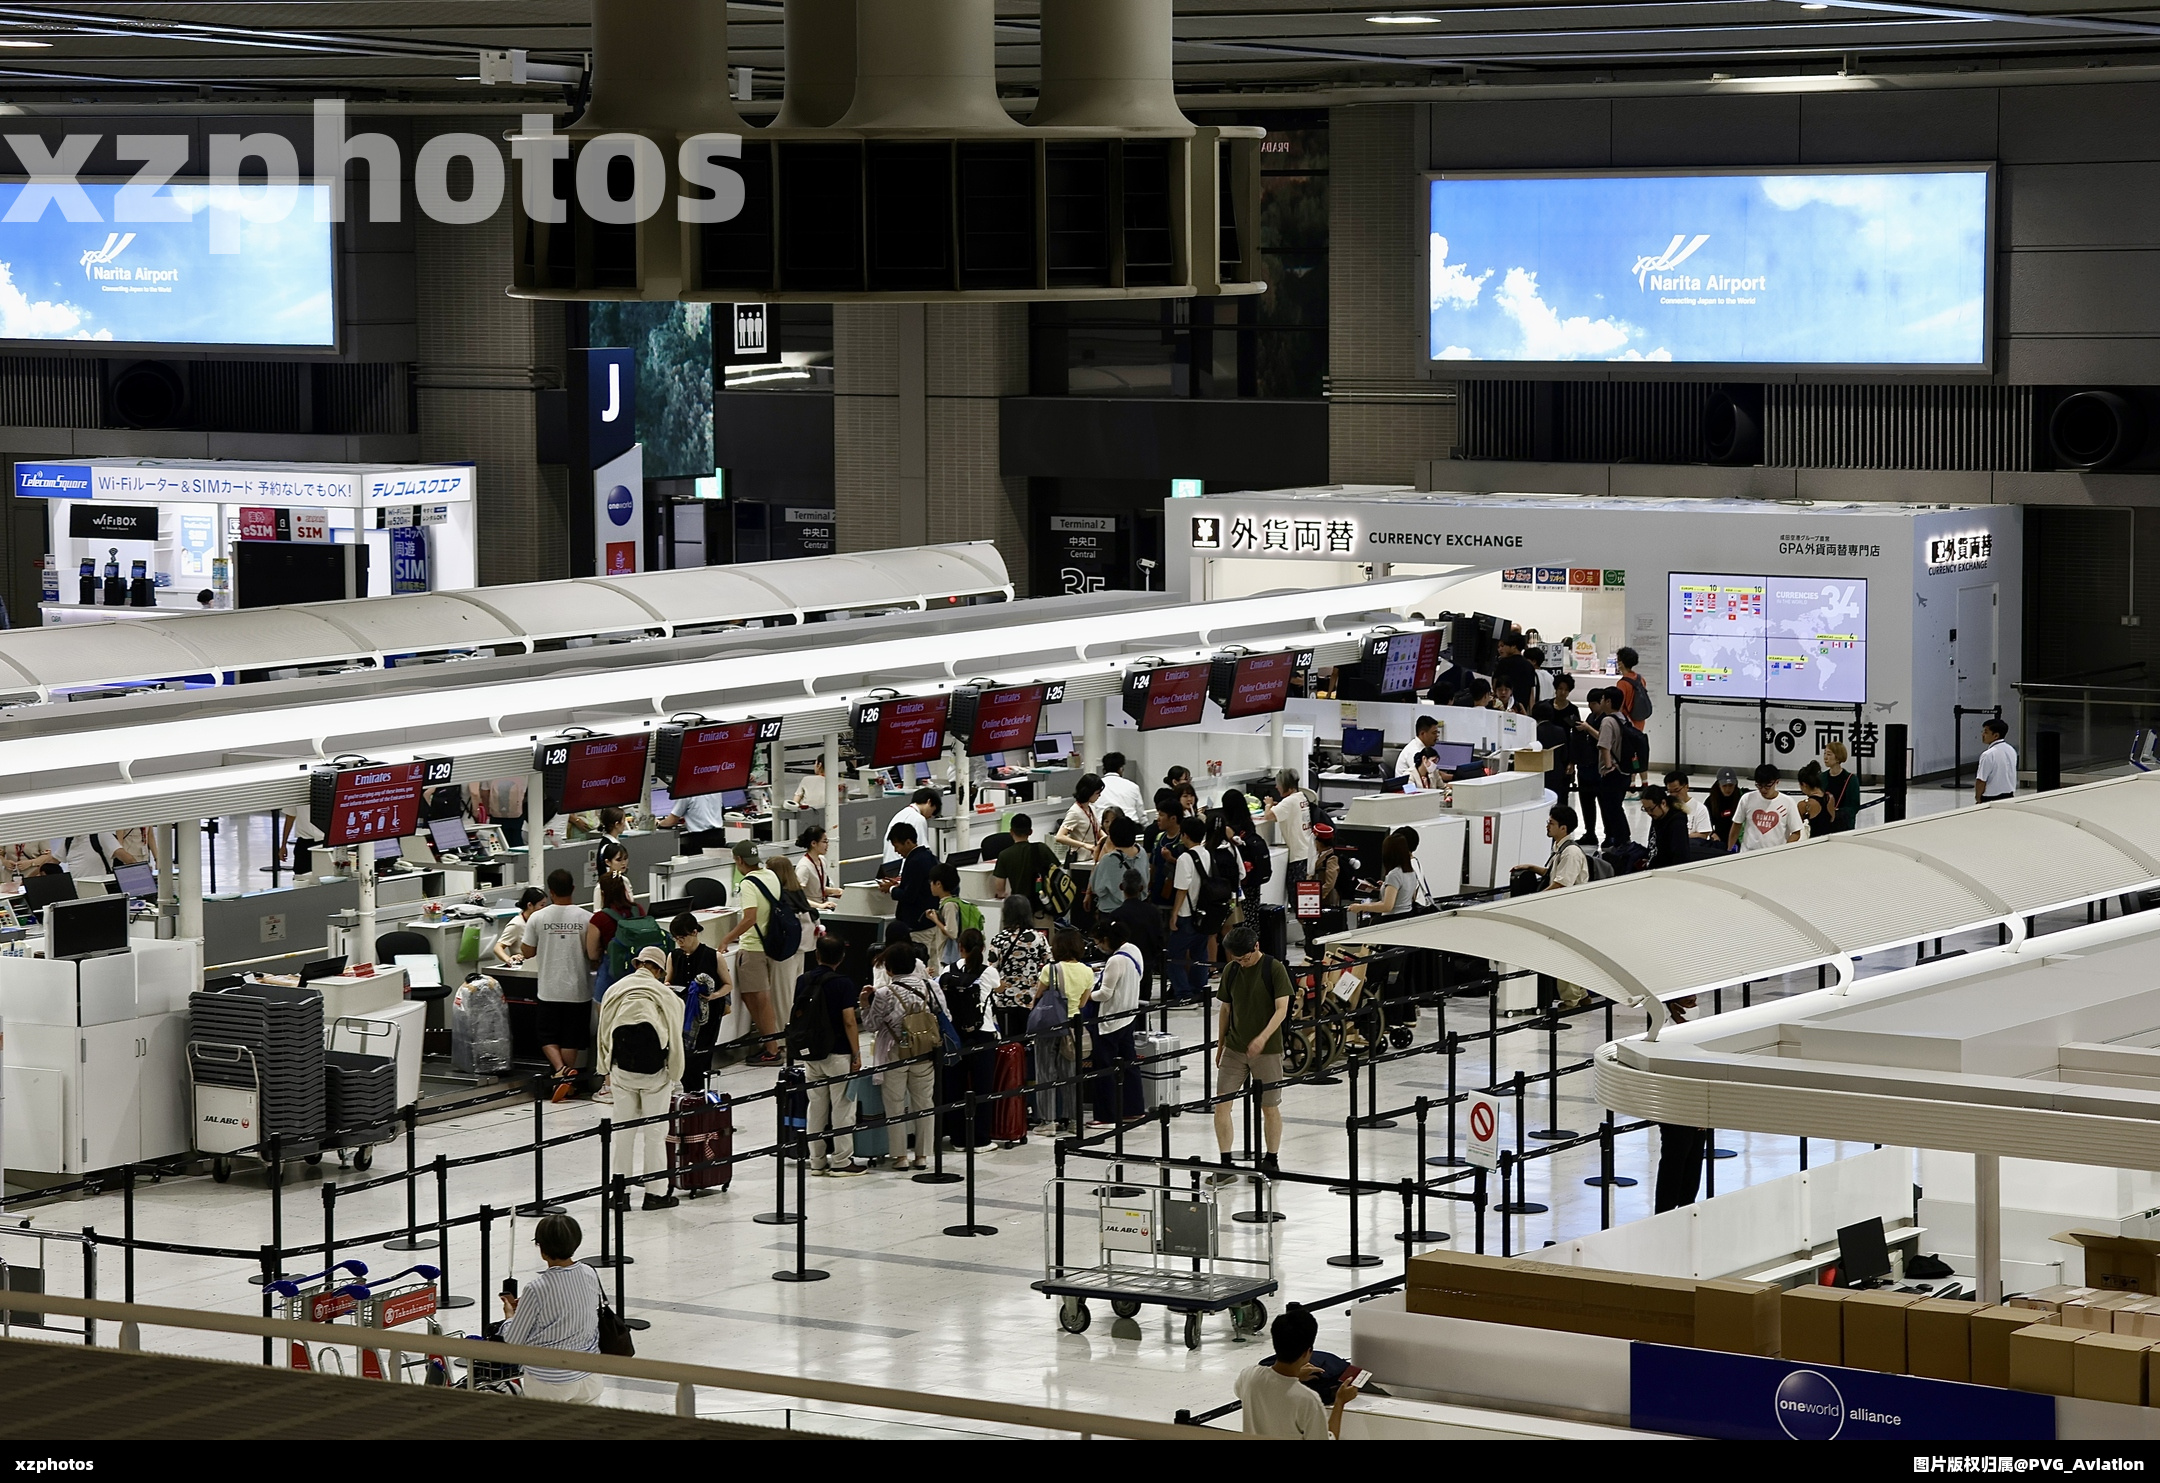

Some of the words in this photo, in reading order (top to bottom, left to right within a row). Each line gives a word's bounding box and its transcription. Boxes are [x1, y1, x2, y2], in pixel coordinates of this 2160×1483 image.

[94, 267, 131, 280] Narita
[135, 267, 179, 284] Airport
[1650, 275, 1700, 290] Narita
[1706, 275, 1766, 294] Airport
[1660, 297, 1696, 305] Connecting
[1697, 297, 1716, 305] Japan
[602, 363, 620, 422] J
[372, 477, 461, 497] テレコムスクエア
[794, 510, 830, 520] Terminal
[242, 525, 273, 537] eSIM
[1060, 519, 1098, 529] Terminal
[1100, 520, 1106, 529] 2
[298, 527, 322, 538] SIM
[803, 528, 829, 537] 中央口
[1231, 517, 1354, 552] 外貨両替
[1369, 531, 1440, 545] CURRENCY
[1446, 534, 1523, 548] EXCHANGE
[804, 541, 828, 549] Central
[1069, 536, 1096, 546] 中央口
[1945, 534, 1993, 562] 外貨両替
[395, 541, 416, 557] 周遊
[1070, 550, 1096, 558] Central
[1779, 542, 1880, 557] GPA外貨両替専門店
[395, 559, 425, 579] SIM
[1928, 564, 1957, 576] CURRENCY
[1958, 560, 1988, 573] EXCHANGE
[1776, 591, 1819, 600] CURRENCIES
[1821, 585, 1859, 618] 34
[1373, 641, 1388, 655] I-22
[1250, 660, 1274, 670] Emirates
[1296, 653, 1312, 667] I-23
[1133, 675, 1150, 689] I-24
[1165, 671, 1190, 681] Emirates
[1046, 686, 1064, 700] I-25
[1239, 684, 1256, 693] Online
[994, 693, 1021, 704] Emirates
[1153, 696, 1171, 705] Online
[1171, 692, 1199, 703] Checked-in
[1246, 693, 1272, 703] Customers
[861, 707, 879, 723] I-26
[897, 703, 924, 714] Emirates
[1160, 705, 1187, 715] Customers
[982, 719, 1000, 729] Online
[1000, 714, 1032, 727] Checked-in
[699, 730, 729, 742] Emirates
[760, 722, 781, 738] I-27
[990, 728, 1019, 739] Customers
[1814, 721, 1878, 758] 両替
[586, 743, 618, 755] Emirates
[546, 748, 567, 765] I-28
[428, 763, 451, 780] I-29
[694, 764, 721, 774] Economy
[721, 762, 736, 770] Class
[354, 772, 392, 786] Emirates
[582, 778, 611, 788] Economy
[611, 775, 626, 784] Class
[220, 1117, 239, 1125] ABC
[394, 1302, 435, 1319] Takashimaya
[1780, 1400, 1839, 1417] oneworld
[1850, 1408, 1902, 1425] alliance
